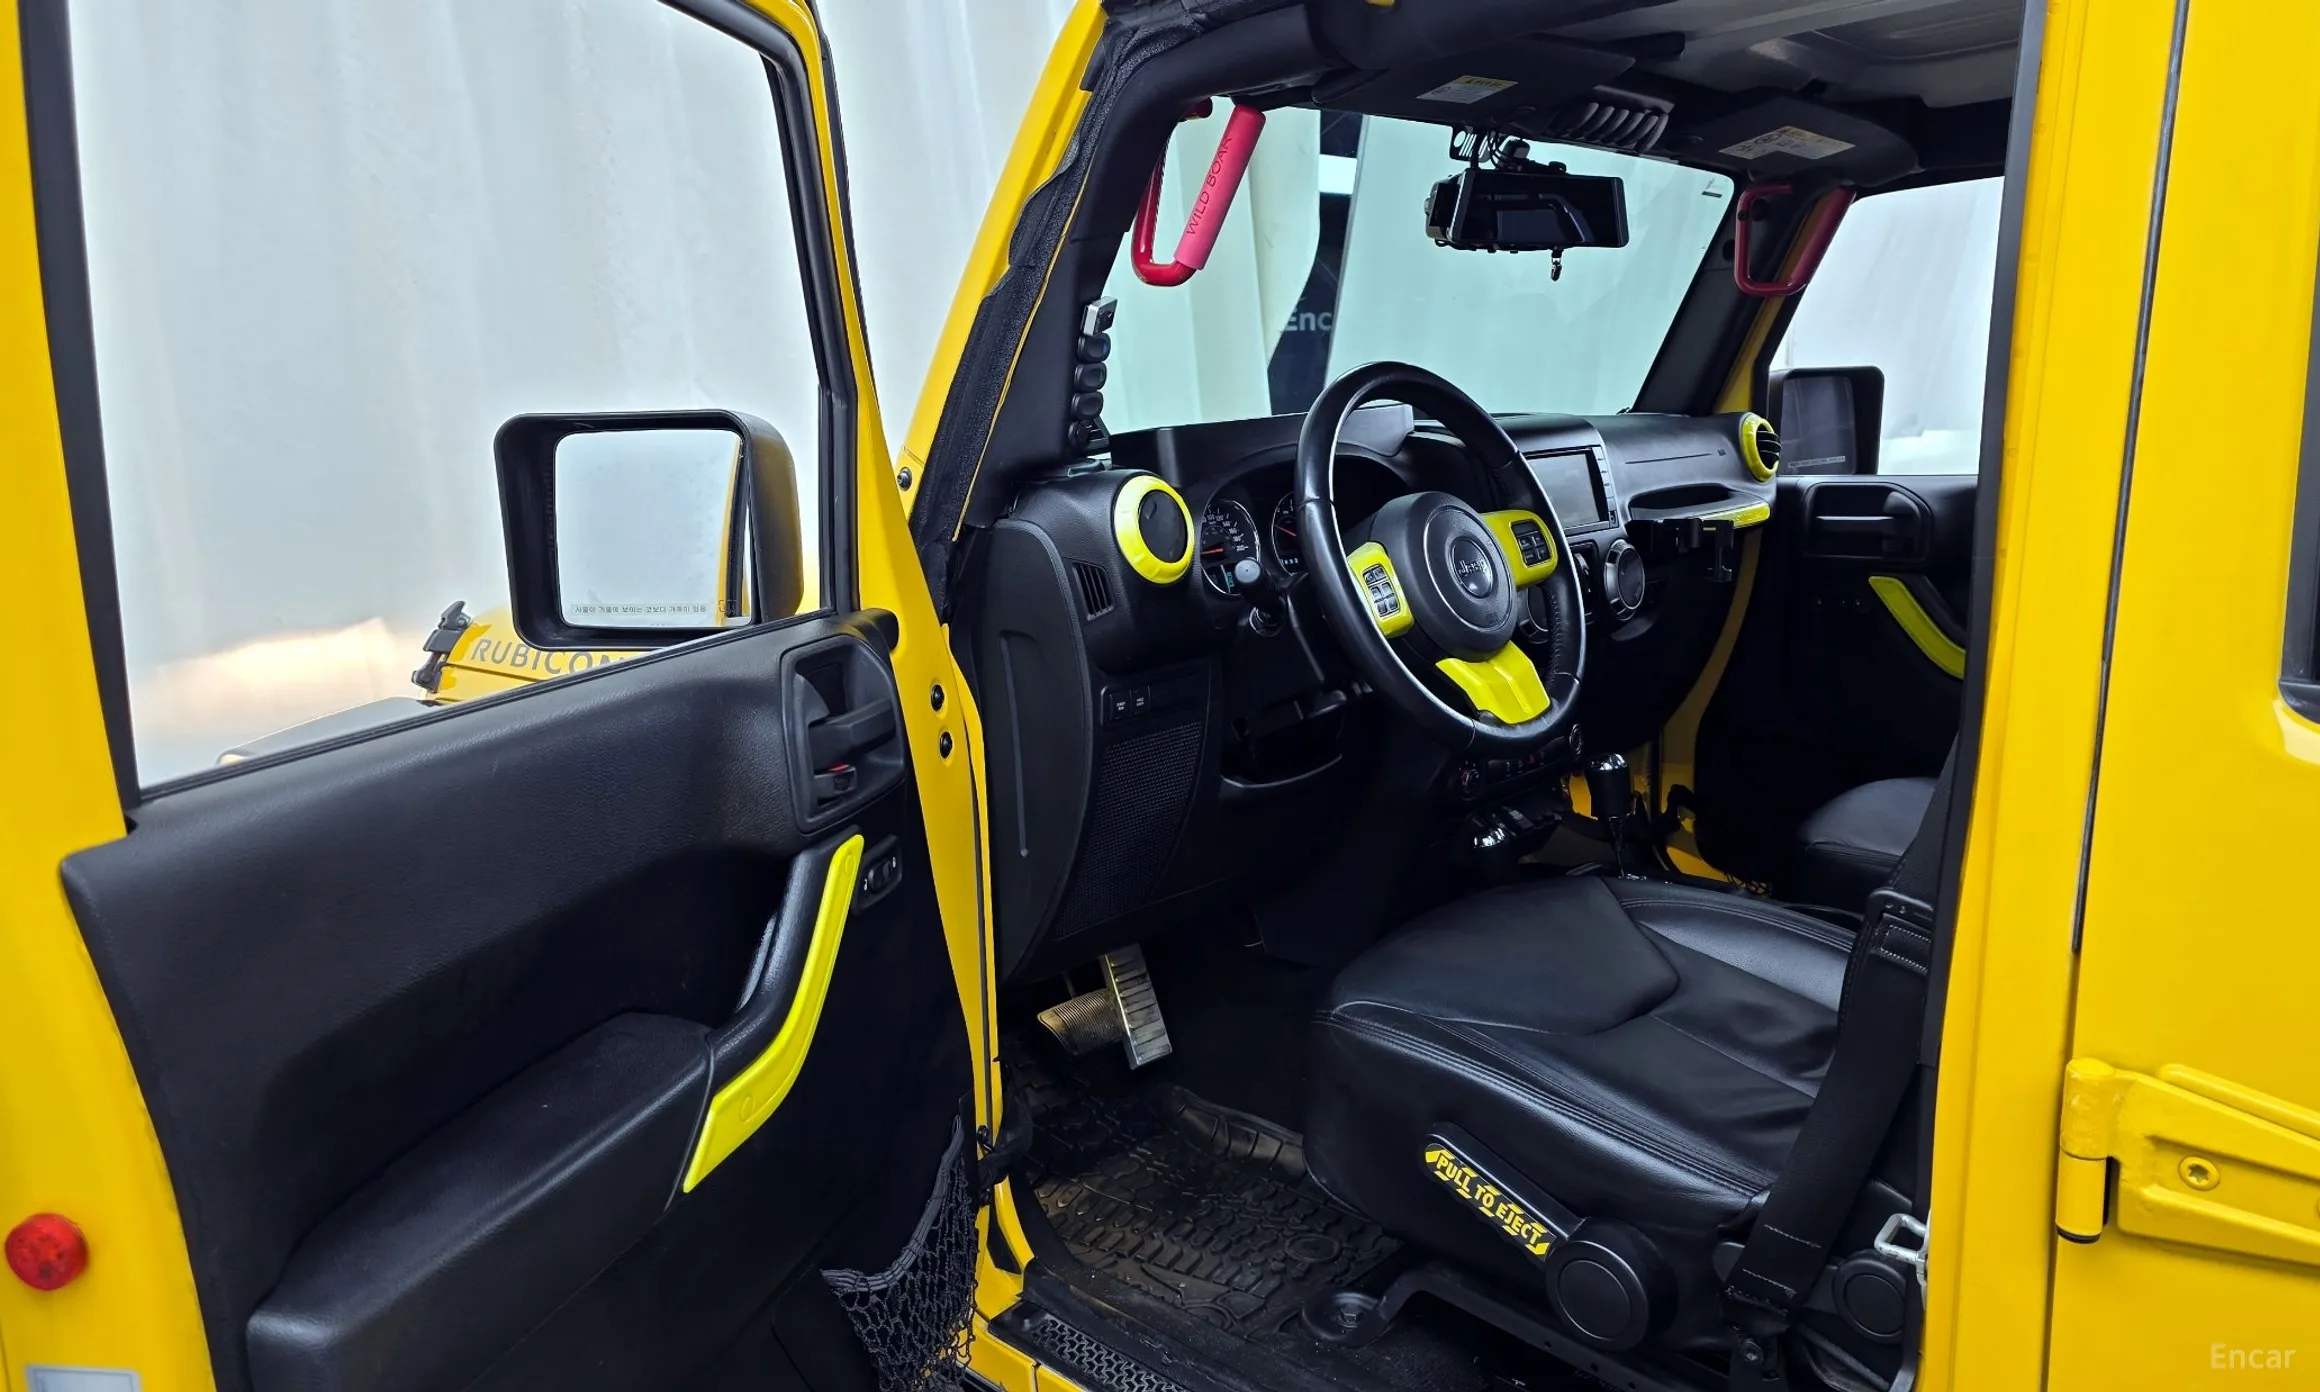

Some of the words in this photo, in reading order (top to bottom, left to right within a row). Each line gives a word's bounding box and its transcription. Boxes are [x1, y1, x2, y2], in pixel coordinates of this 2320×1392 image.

[1186, 191, 1210, 235] WILD
[1206, 136, 1232, 188] BOAR
[621, 606, 643, 614] 보이는
[1436, 1155, 1471, 1193] PULL
[1474, 1184, 1495, 1208] TO
[1495, 1202, 1542, 1245] EJECT
